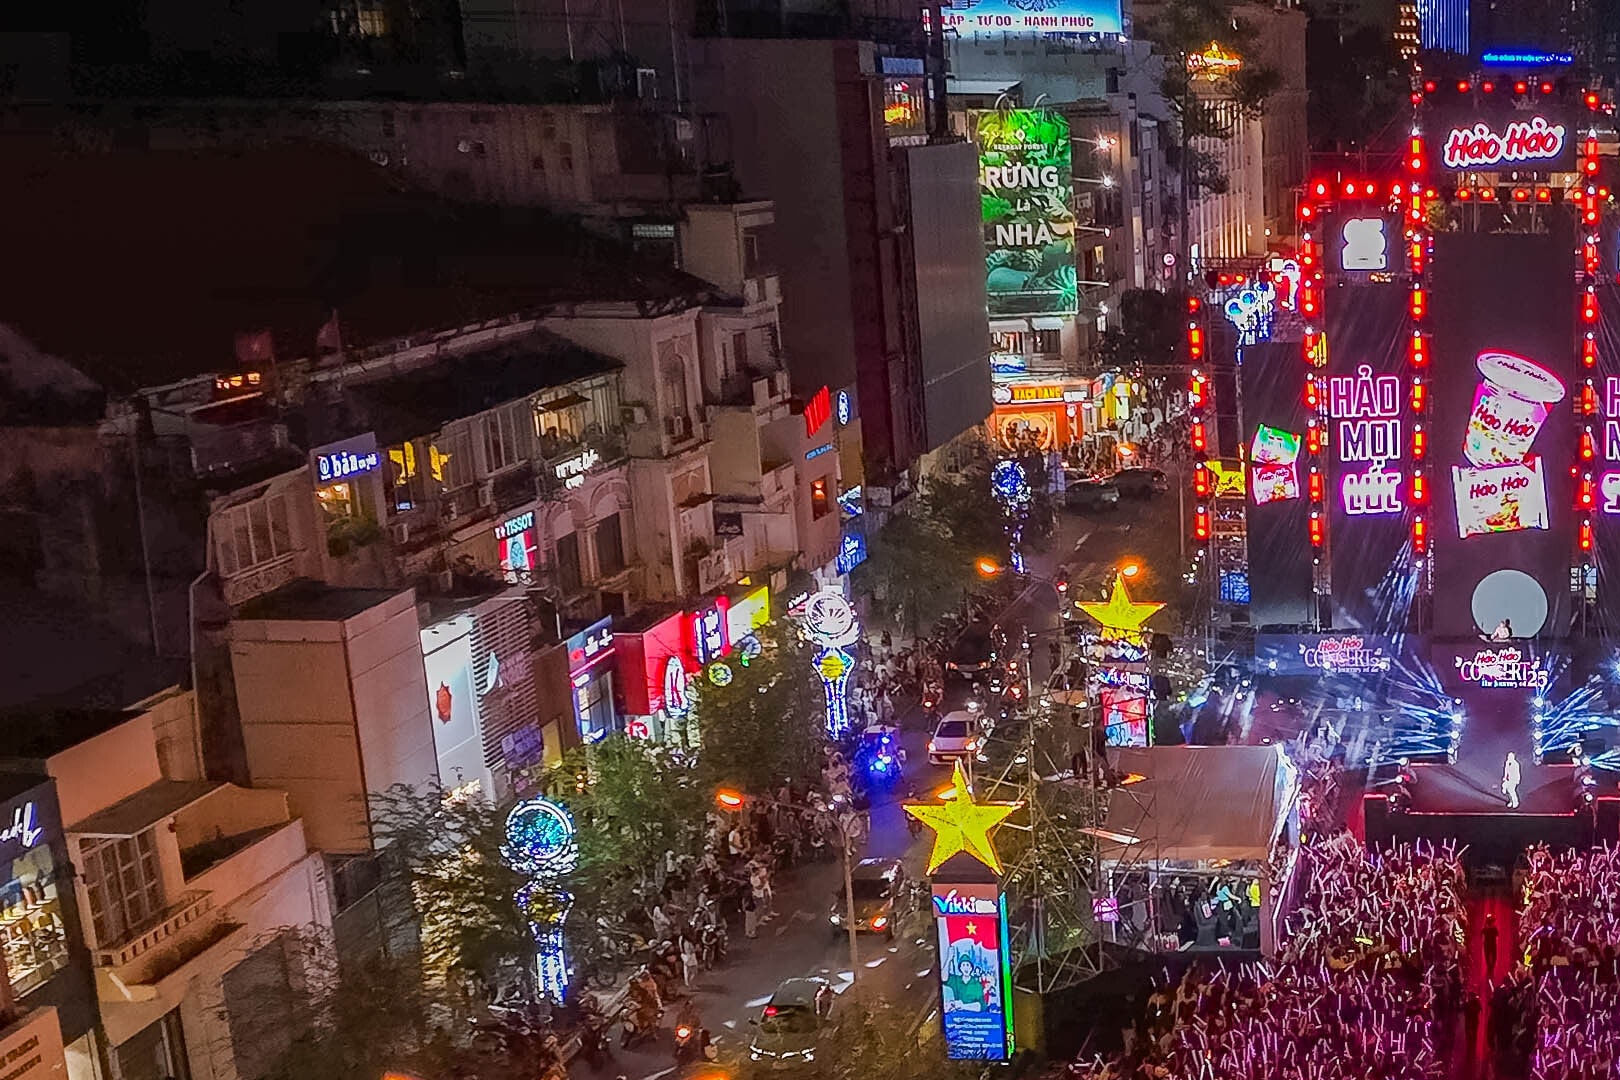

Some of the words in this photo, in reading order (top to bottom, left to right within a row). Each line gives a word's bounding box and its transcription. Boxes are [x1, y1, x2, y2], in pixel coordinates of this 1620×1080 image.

[1443, 123, 1501, 168] Hảo
[1501, 116, 1566, 161] Hảo
[984, 160, 1059, 189] RỪNG
[995, 218, 1054, 246] NHÀ
[1331, 365, 1399, 418] HẢO
[1340, 420, 1400, 468] MỌI
[504, 511, 533, 536] TISSOT
[933, 889, 976, 914] Vikki
